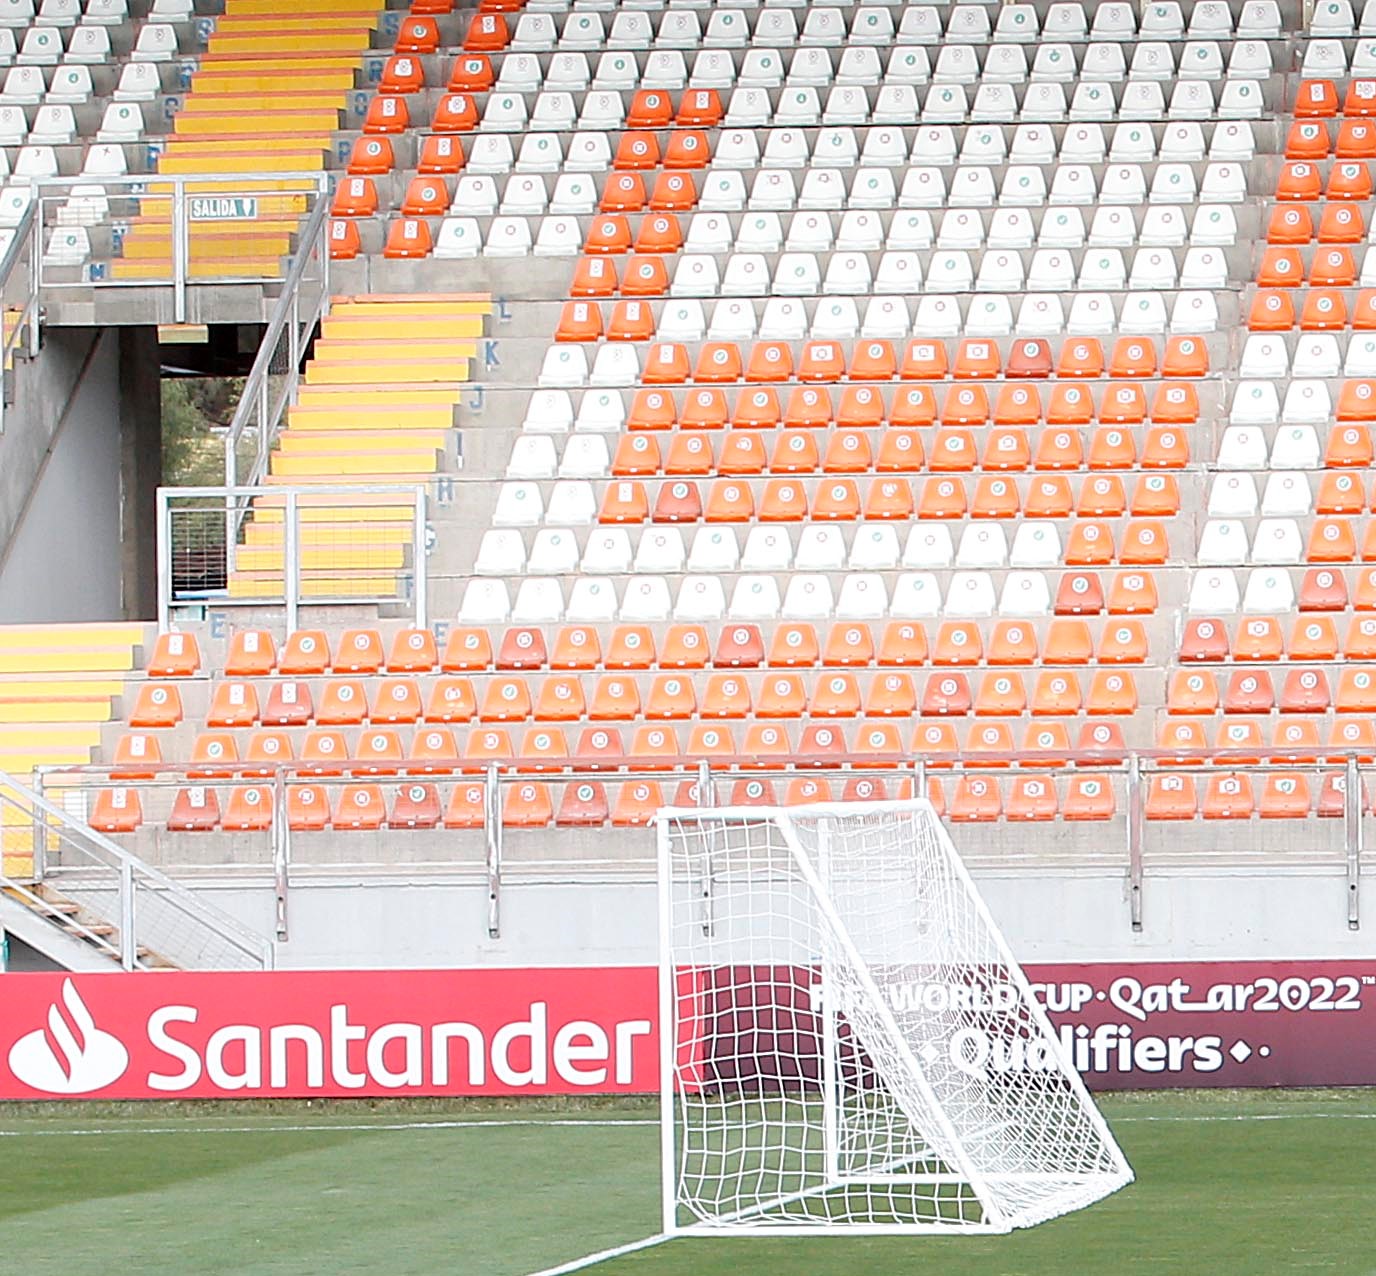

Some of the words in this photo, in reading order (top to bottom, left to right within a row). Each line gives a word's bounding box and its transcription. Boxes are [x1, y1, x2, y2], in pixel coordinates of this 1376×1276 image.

[192, 198, 238, 217] SALIDA
[498, 297, 512, 319] L
[485, 341, 500, 365] K
[469, 387, 483, 409] J
[210, 613, 226, 639] E
[889, 983, 1018, 1012] WORLD
[146, 1001, 652, 1091] Santander
[949, 1023, 1223, 1081] Qualifiers
